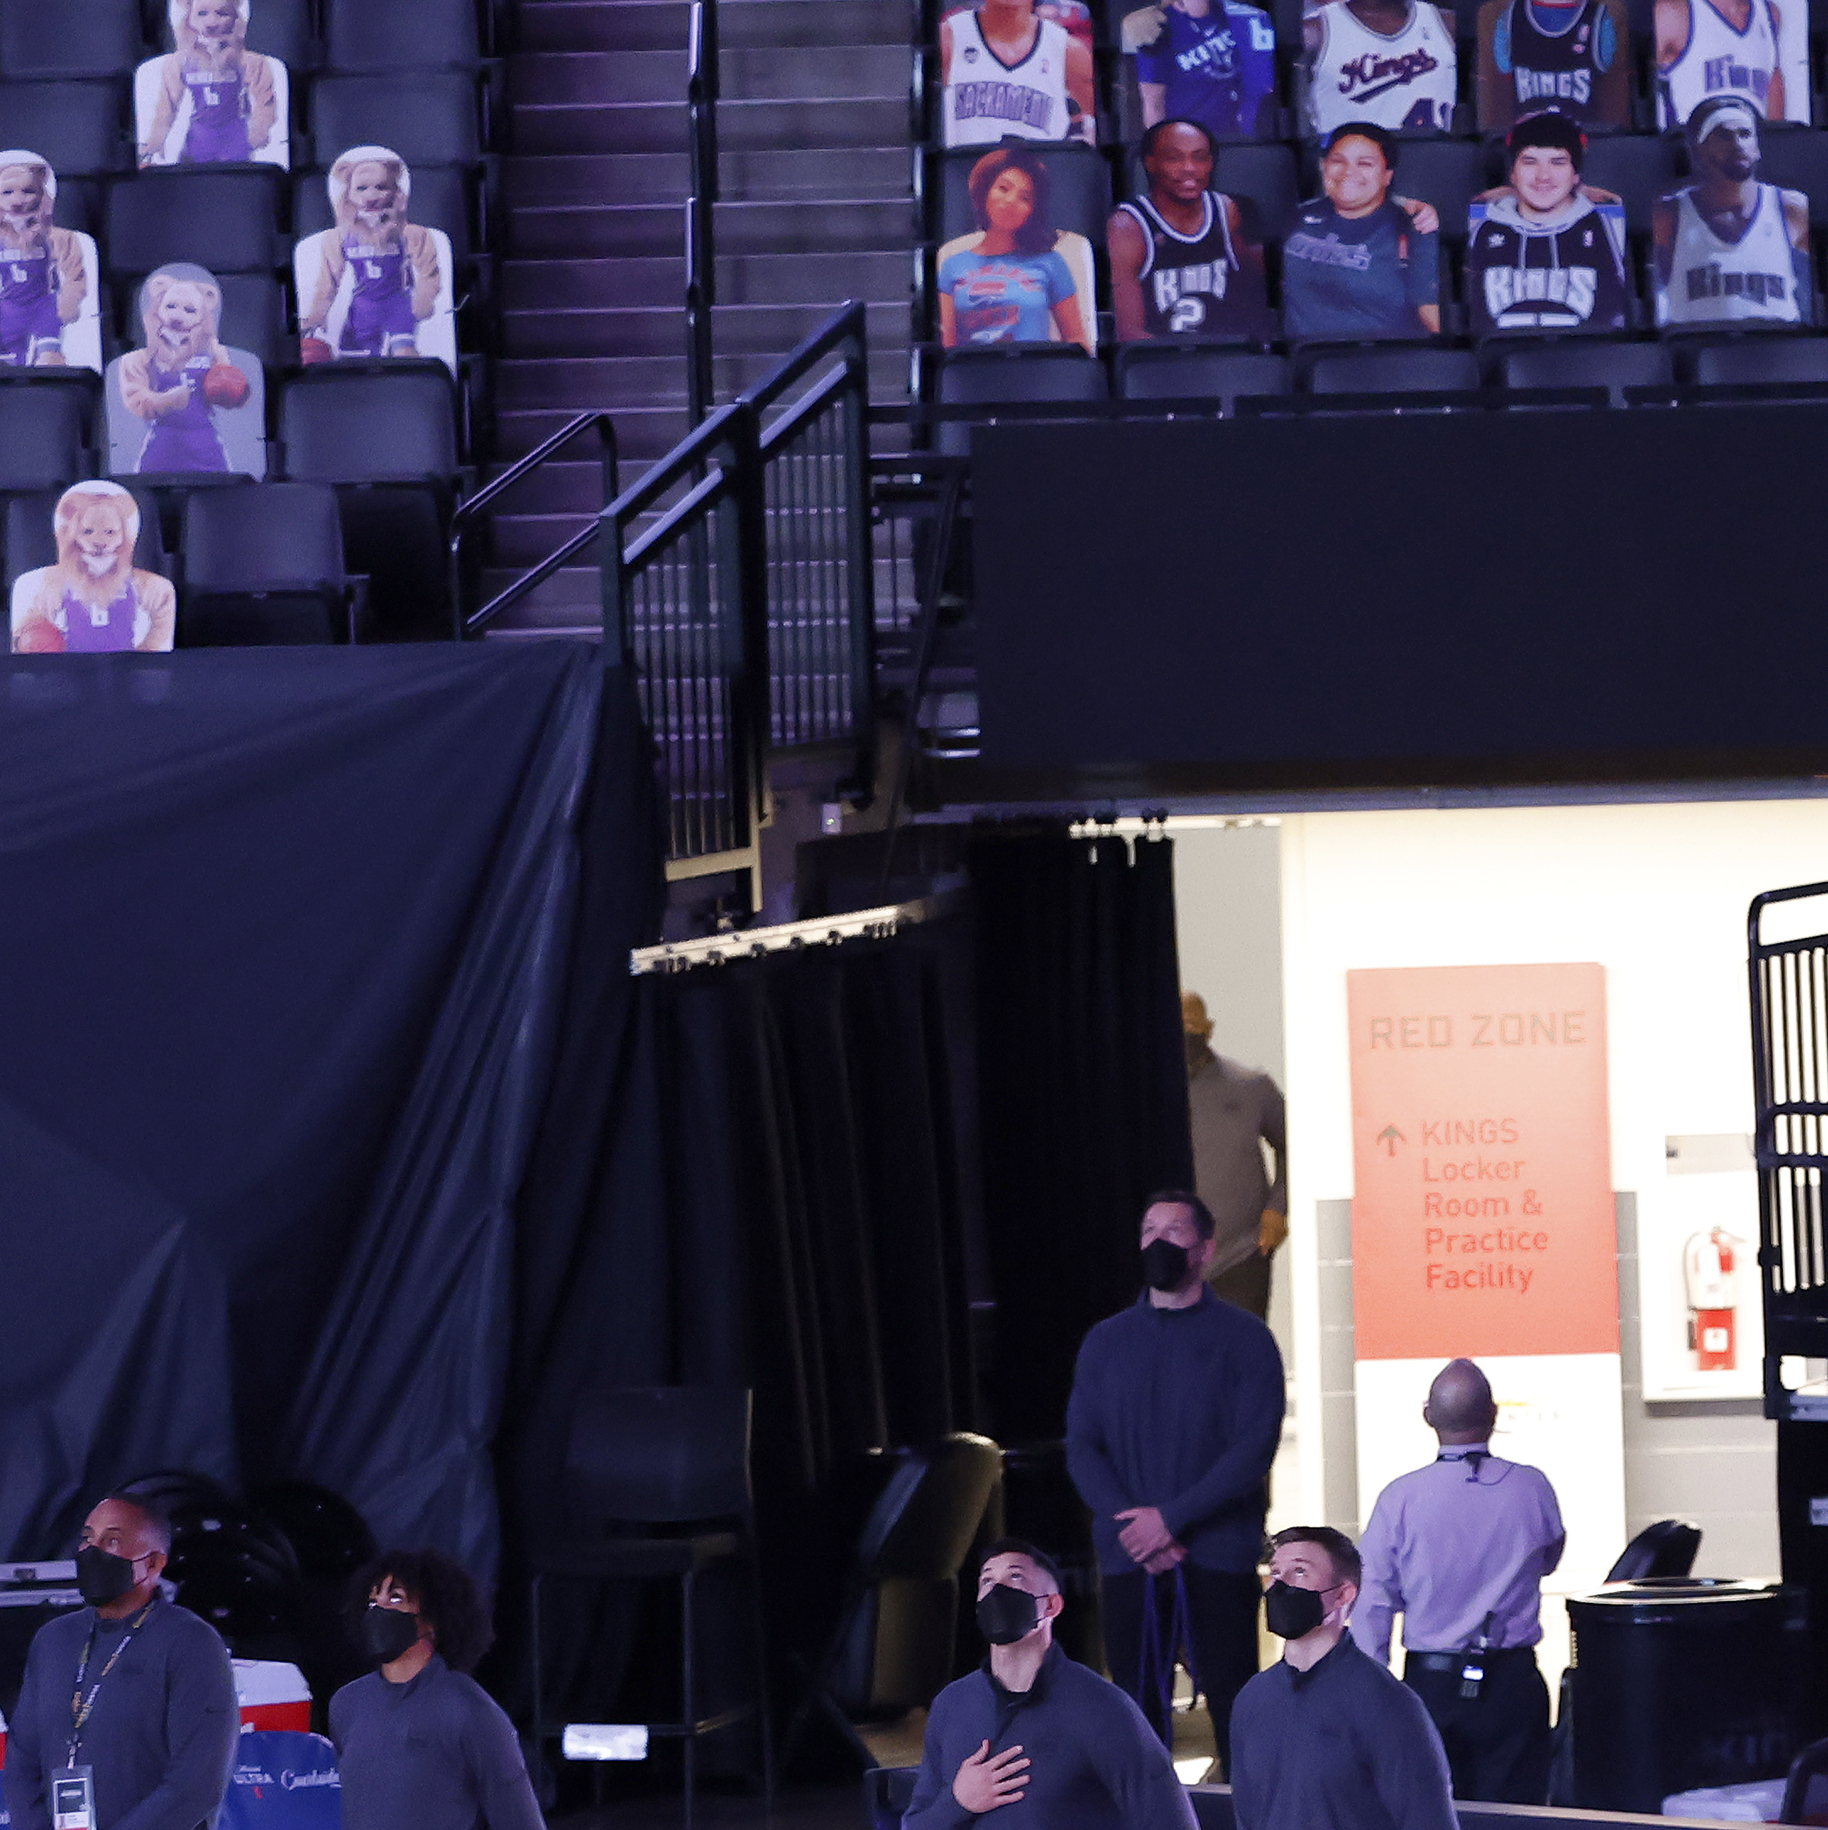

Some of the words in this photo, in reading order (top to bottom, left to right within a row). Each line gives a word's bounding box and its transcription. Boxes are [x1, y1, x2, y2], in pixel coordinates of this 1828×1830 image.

[1339, 47, 1438, 104] Kings
[1514, 66, 1592, 104] KINGS
[1483, 265, 1598, 320] KINGS
[1370, 1013, 1453, 1050] RED
[1471, 1010, 1587, 1047] ZONE
[1420, 1117, 1520, 1148] KINGS
[1423, 1156, 1526, 1184] Locker
[1424, 1193, 1511, 1219] Room
[1522, 1189, 1544, 1217] &
[1424, 1226, 1549, 1257] Practice
[1425, 1263, 1534, 1295] Facility
